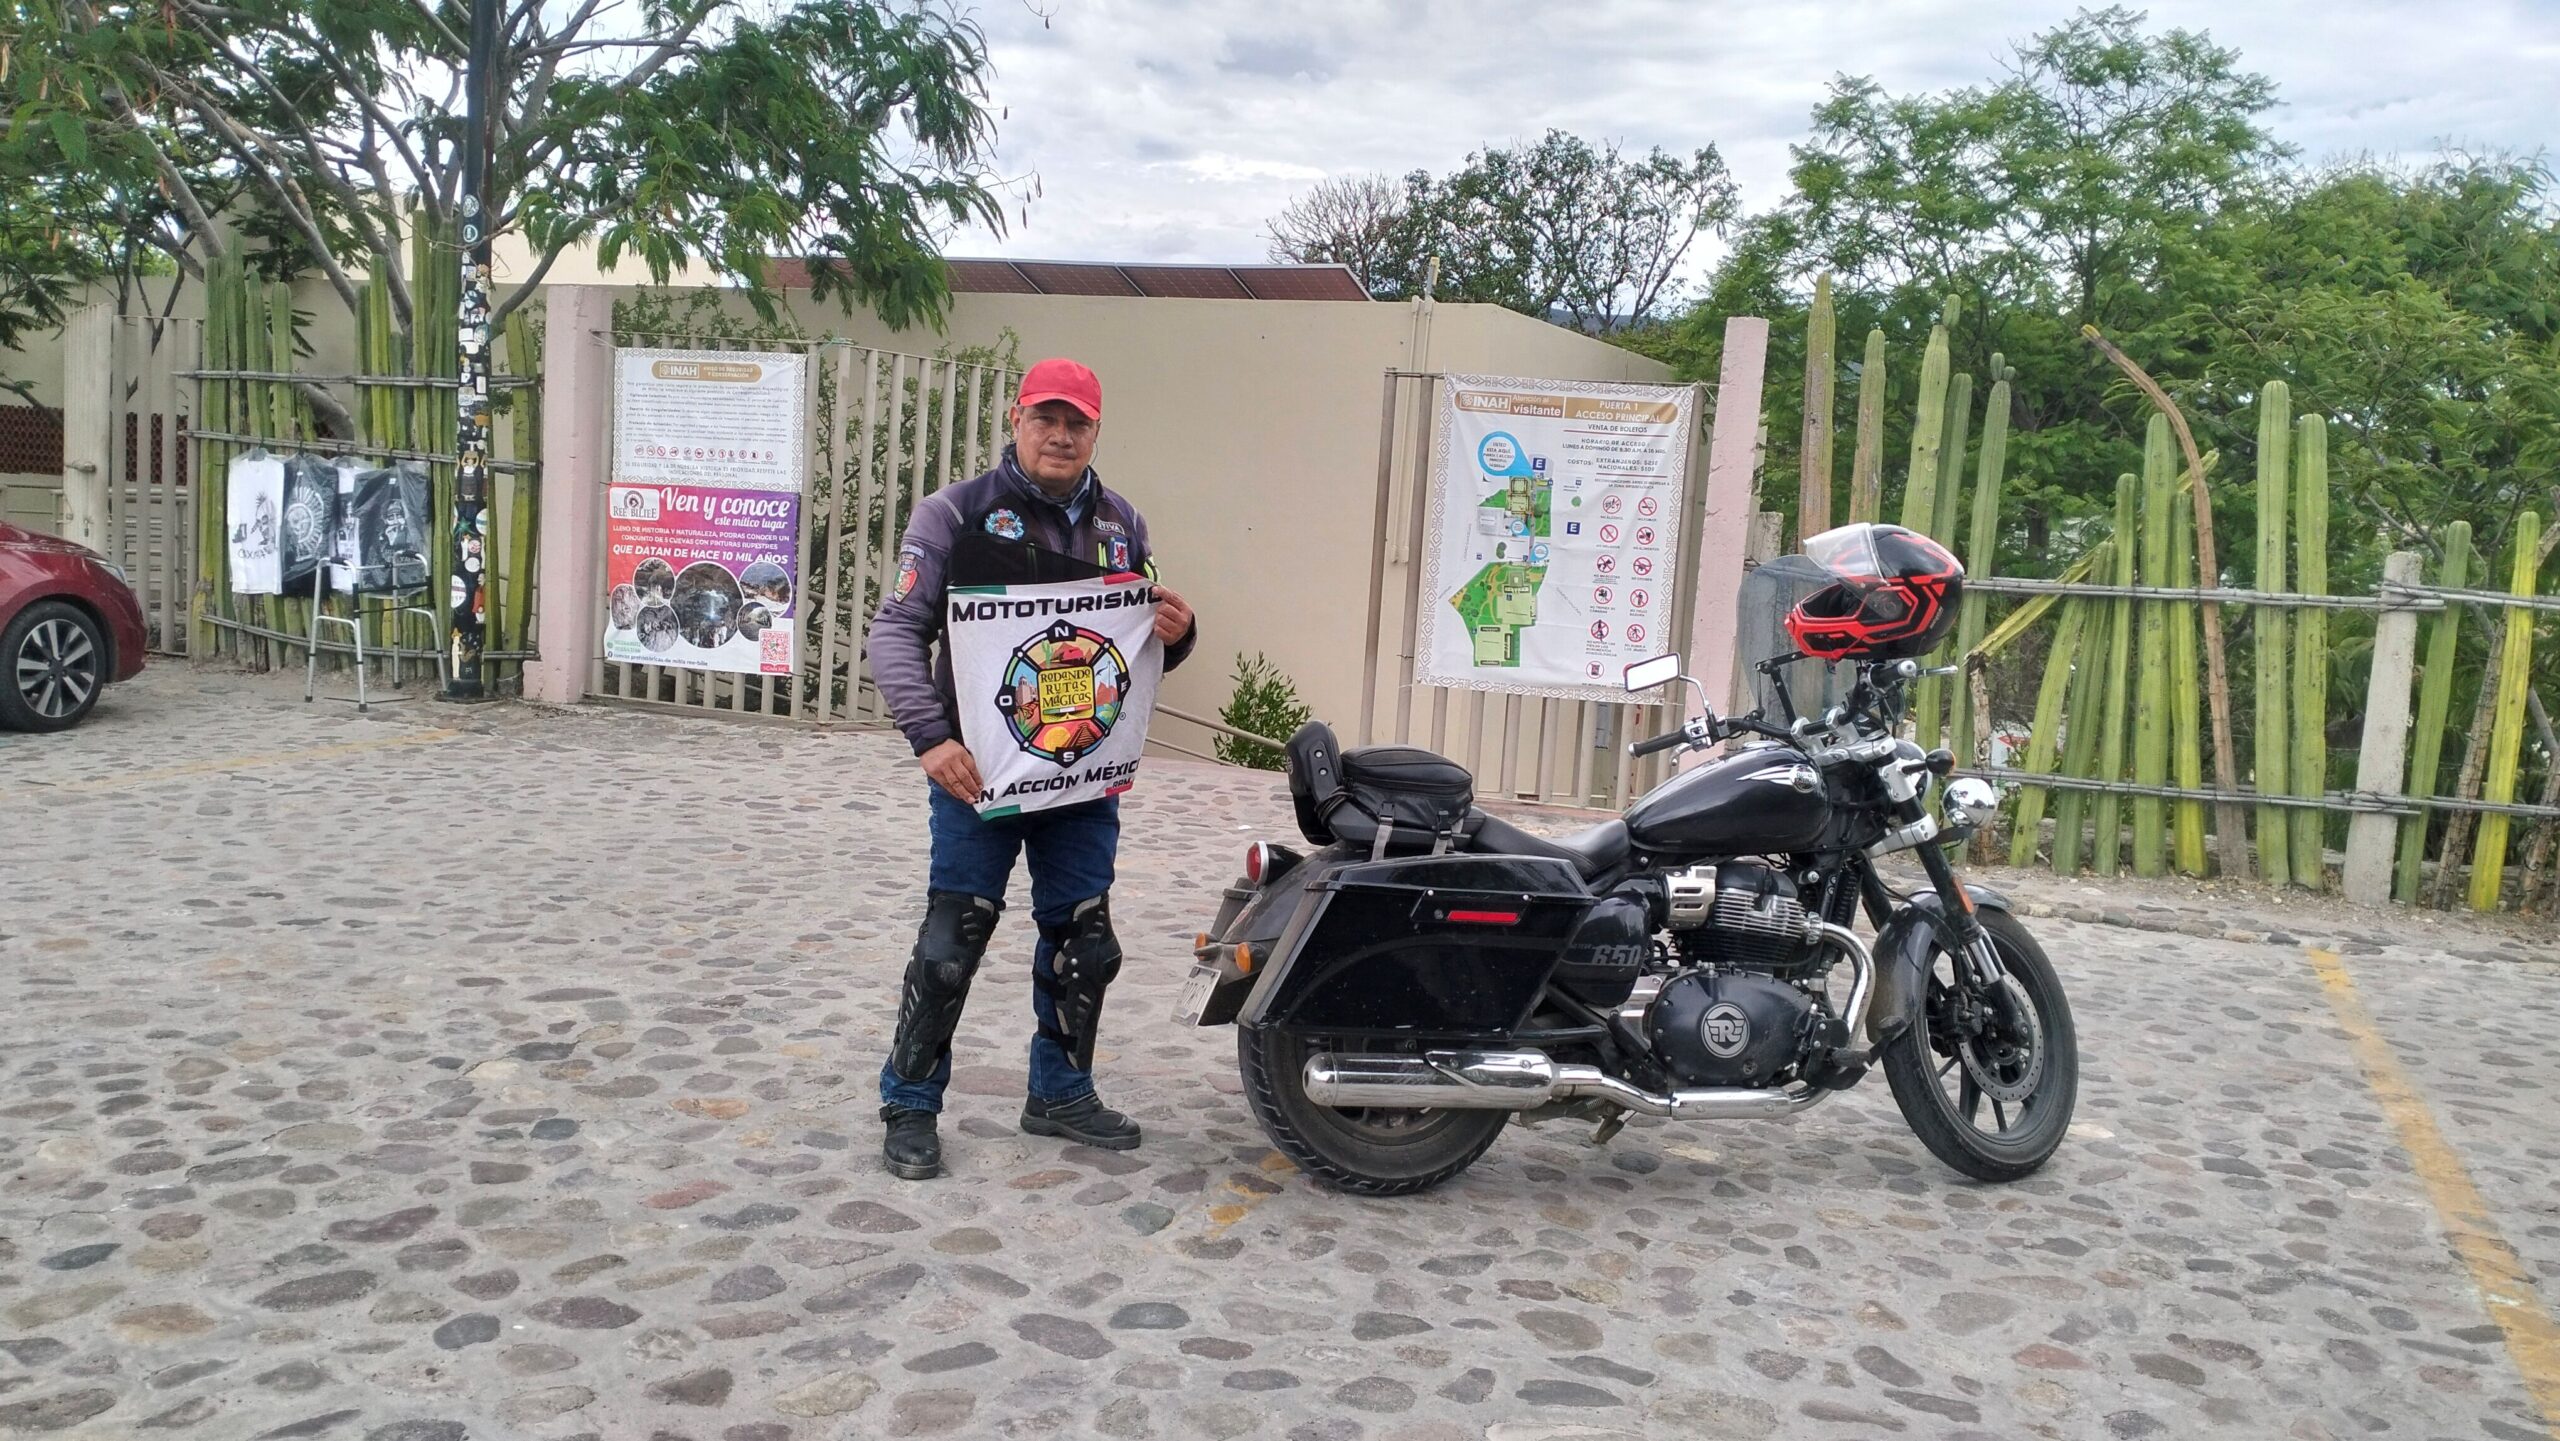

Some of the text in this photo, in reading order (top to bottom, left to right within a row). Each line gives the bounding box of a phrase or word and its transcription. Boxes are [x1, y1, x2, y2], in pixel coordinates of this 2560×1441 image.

[670, 365, 697, 376] INAH
[1473, 396, 1508, 409] INAH
[1600, 400, 1638, 411] PUERTA 1
[1513, 404, 1561, 416] visitante
[1575, 410, 1661, 423] ACCESO PRINCIPAL
[1588, 423, 1608, 432] VENTA
[1567, 458, 1593, 466] COSTOS:
[661, 486, 790, 521] Ven y conoce
[714, 516, 788, 532] este mítico lugar
[621, 534, 654, 542] CONJUNTO
[669, 537, 694, 545] CUEVAS
[710, 540, 741, 548] PINTURAS
[742, 542, 778, 550] RUPESTRES
[746, 533, 778, 541] CONOCER
[613, 544, 789, 565] QUE DATAN DE HACE 10 MIL AÑOS
[1054, 626, 1070, 638] N
[1120, 681, 1128, 692] E
[999, 695, 1013, 706] O
[1062, 751, 1075, 762] S
[974, 757, 1141, 804] N ACCIÓN MÉXIC
[1591, 944, 1642, 967] 650
